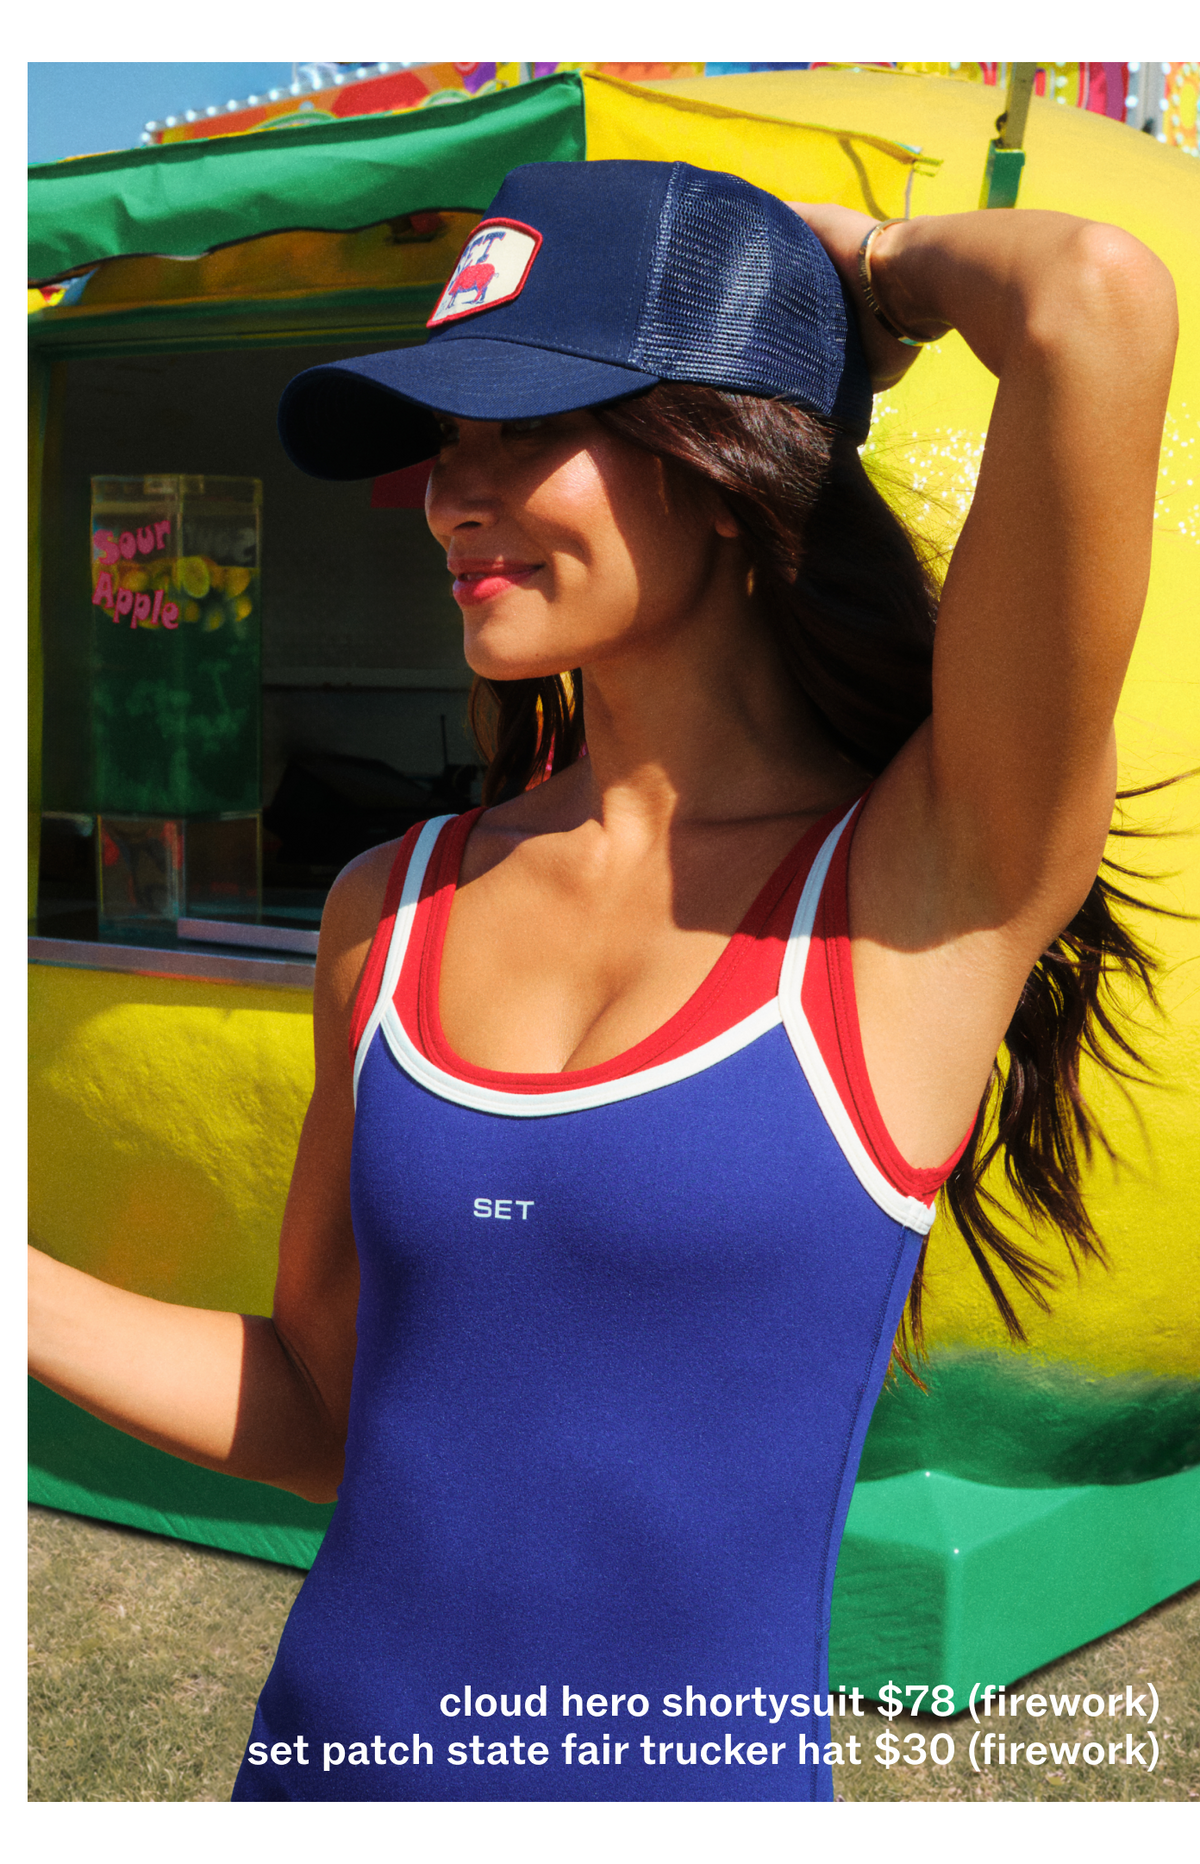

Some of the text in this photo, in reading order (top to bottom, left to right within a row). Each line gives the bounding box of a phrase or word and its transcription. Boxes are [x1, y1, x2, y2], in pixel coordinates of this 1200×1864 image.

[93, 519, 171, 565] Sour
[92, 570, 179, 630] Apple
[473, 1197, 535, 1220] SET
